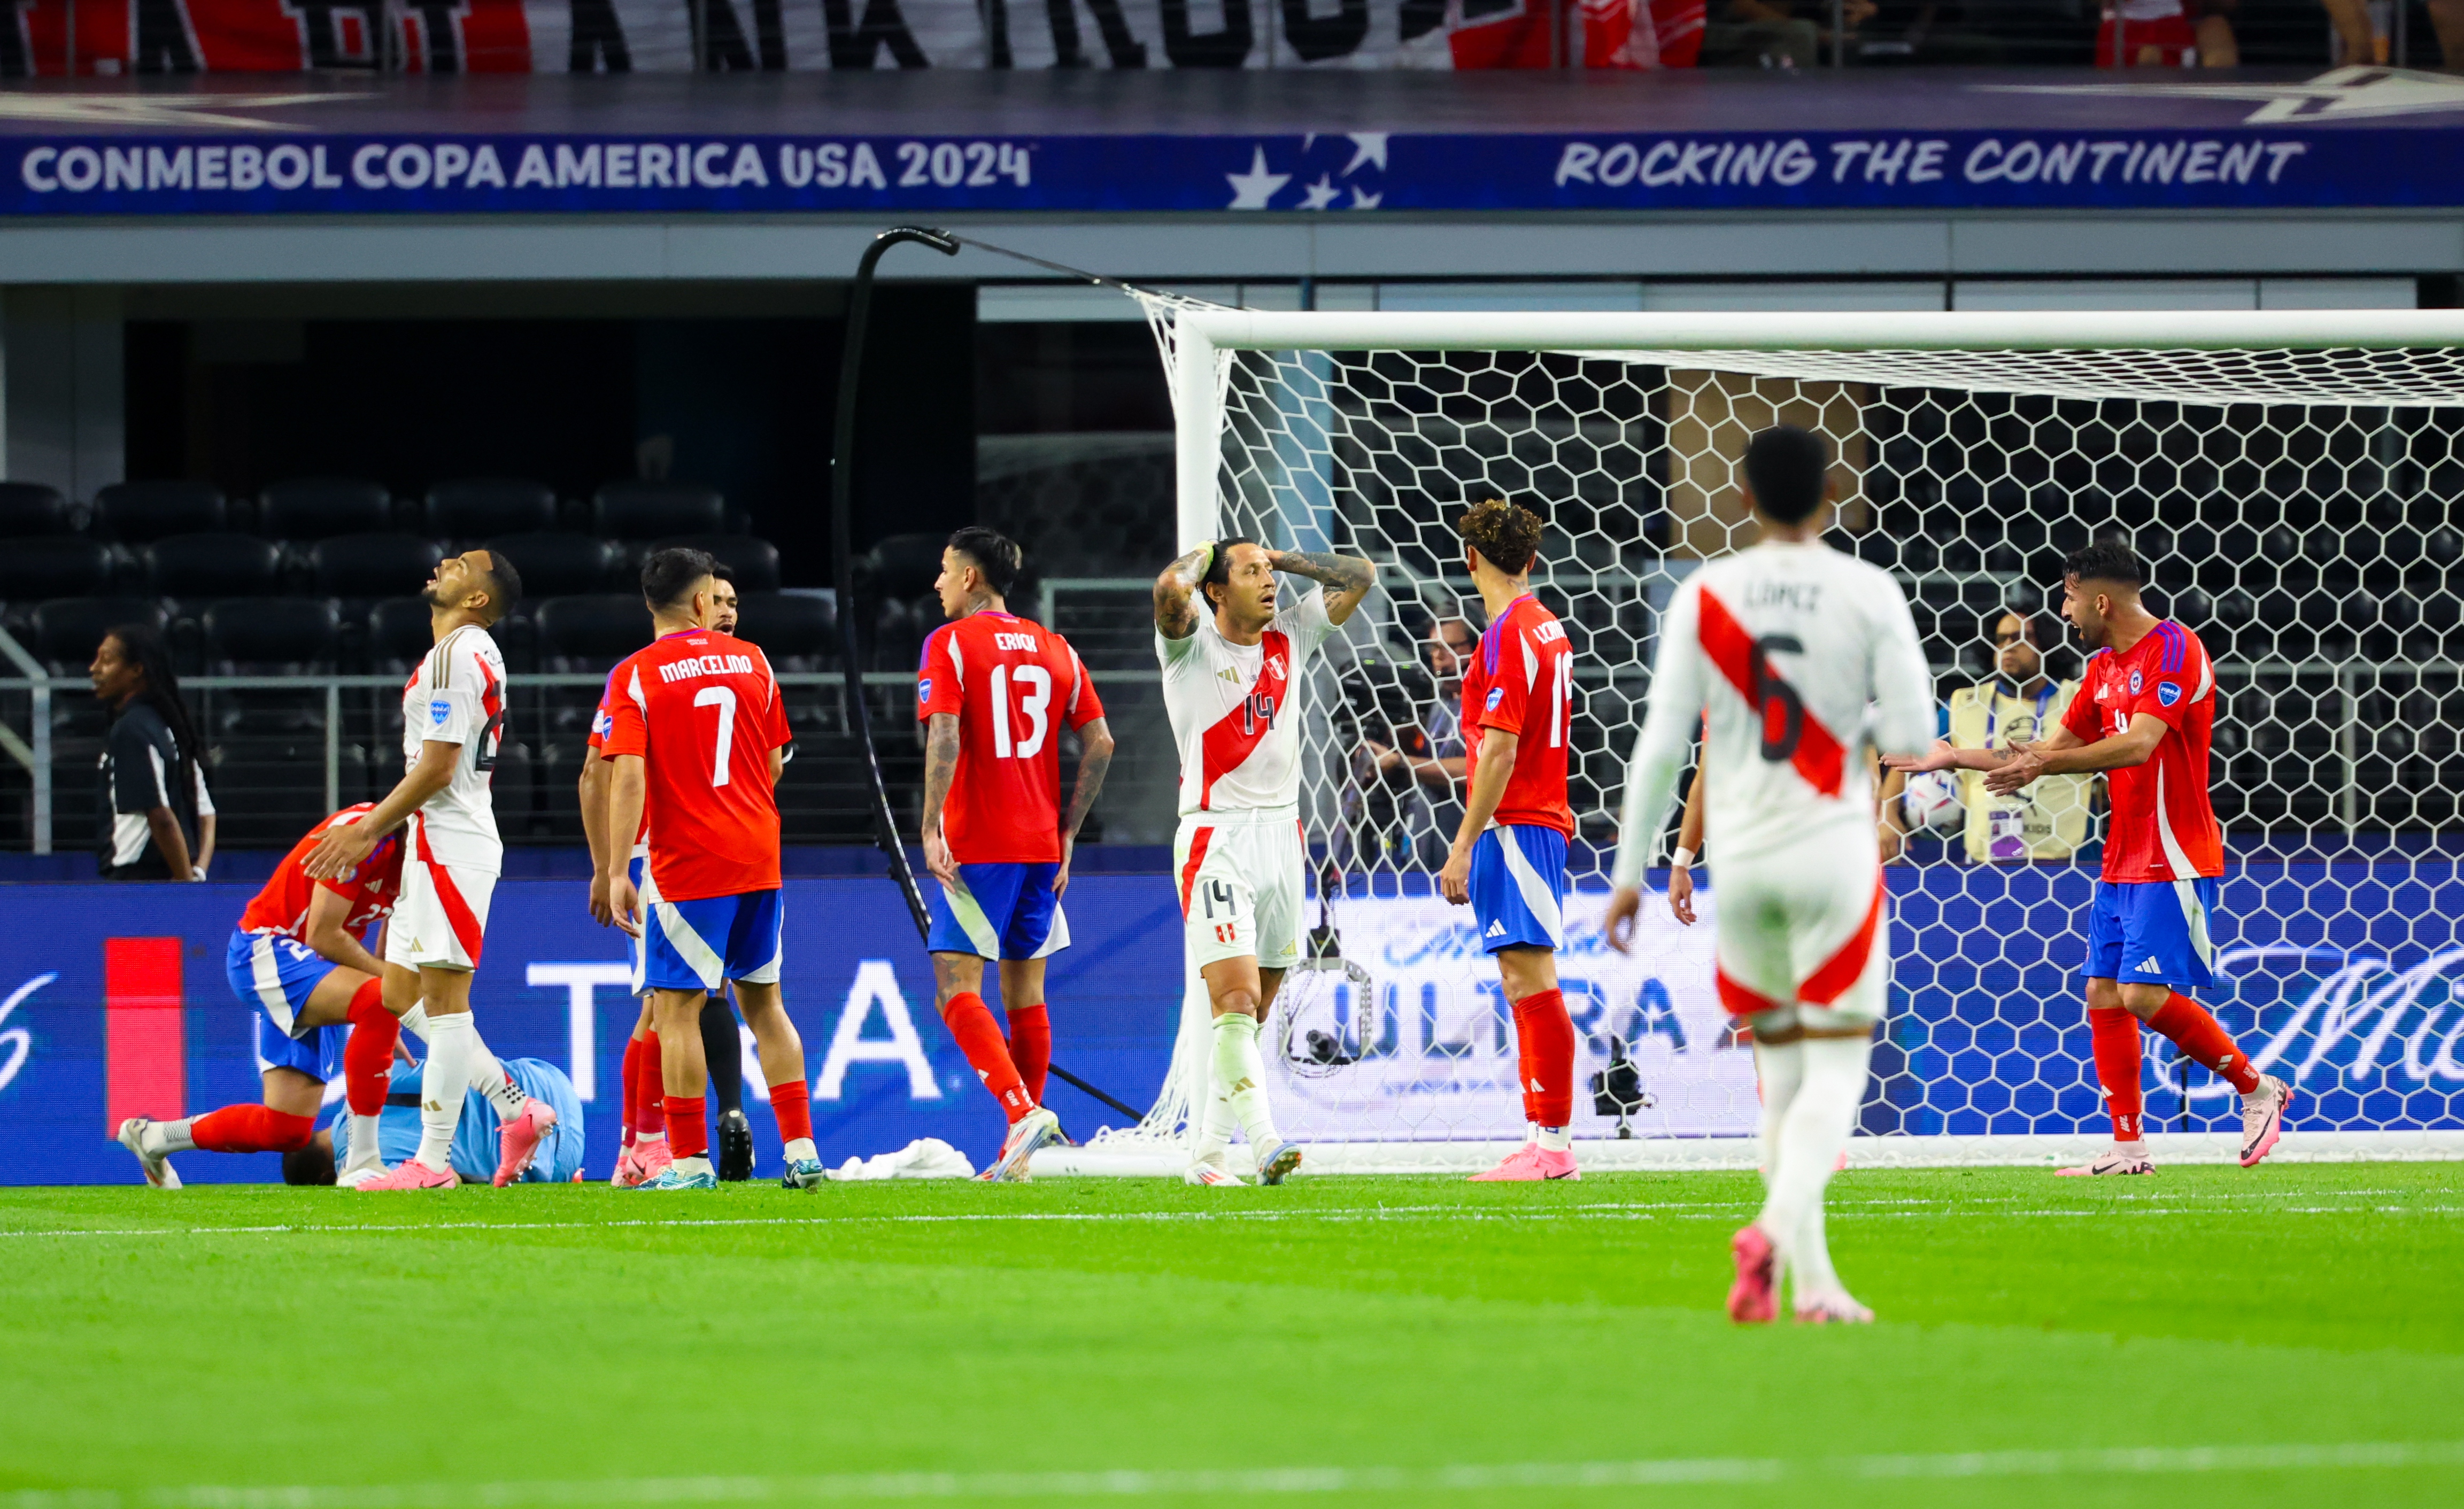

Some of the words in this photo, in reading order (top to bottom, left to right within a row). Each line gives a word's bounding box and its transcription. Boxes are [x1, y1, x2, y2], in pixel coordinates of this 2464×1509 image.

[22, 145, 343, 192] CONMEBOL
[352, 144, 507, 189] COPA
[514, 143, 770, 189] AMERICA
[779, 143, 887, 190] USA
[897, 142, 1031, 187] 2024
[1555, 139, 1818, 187] ROCKING
[1831, 140, 1950, 185] THE
[1964, 140, 2307, 184] CONTINENT
[994, 633, 1038, 653] ERICK
[659, 655, 753, 684] MARCELINO
[2160, 686, 2178, 697] VIBRA
[991, 664, 1052, 759] 13
[1245, 692, 1275, 735] 14
[1749, 633, 1804, 761] 6
[694, 686, 737, 787] 7
[1202, 879, 1237, 918] 14
